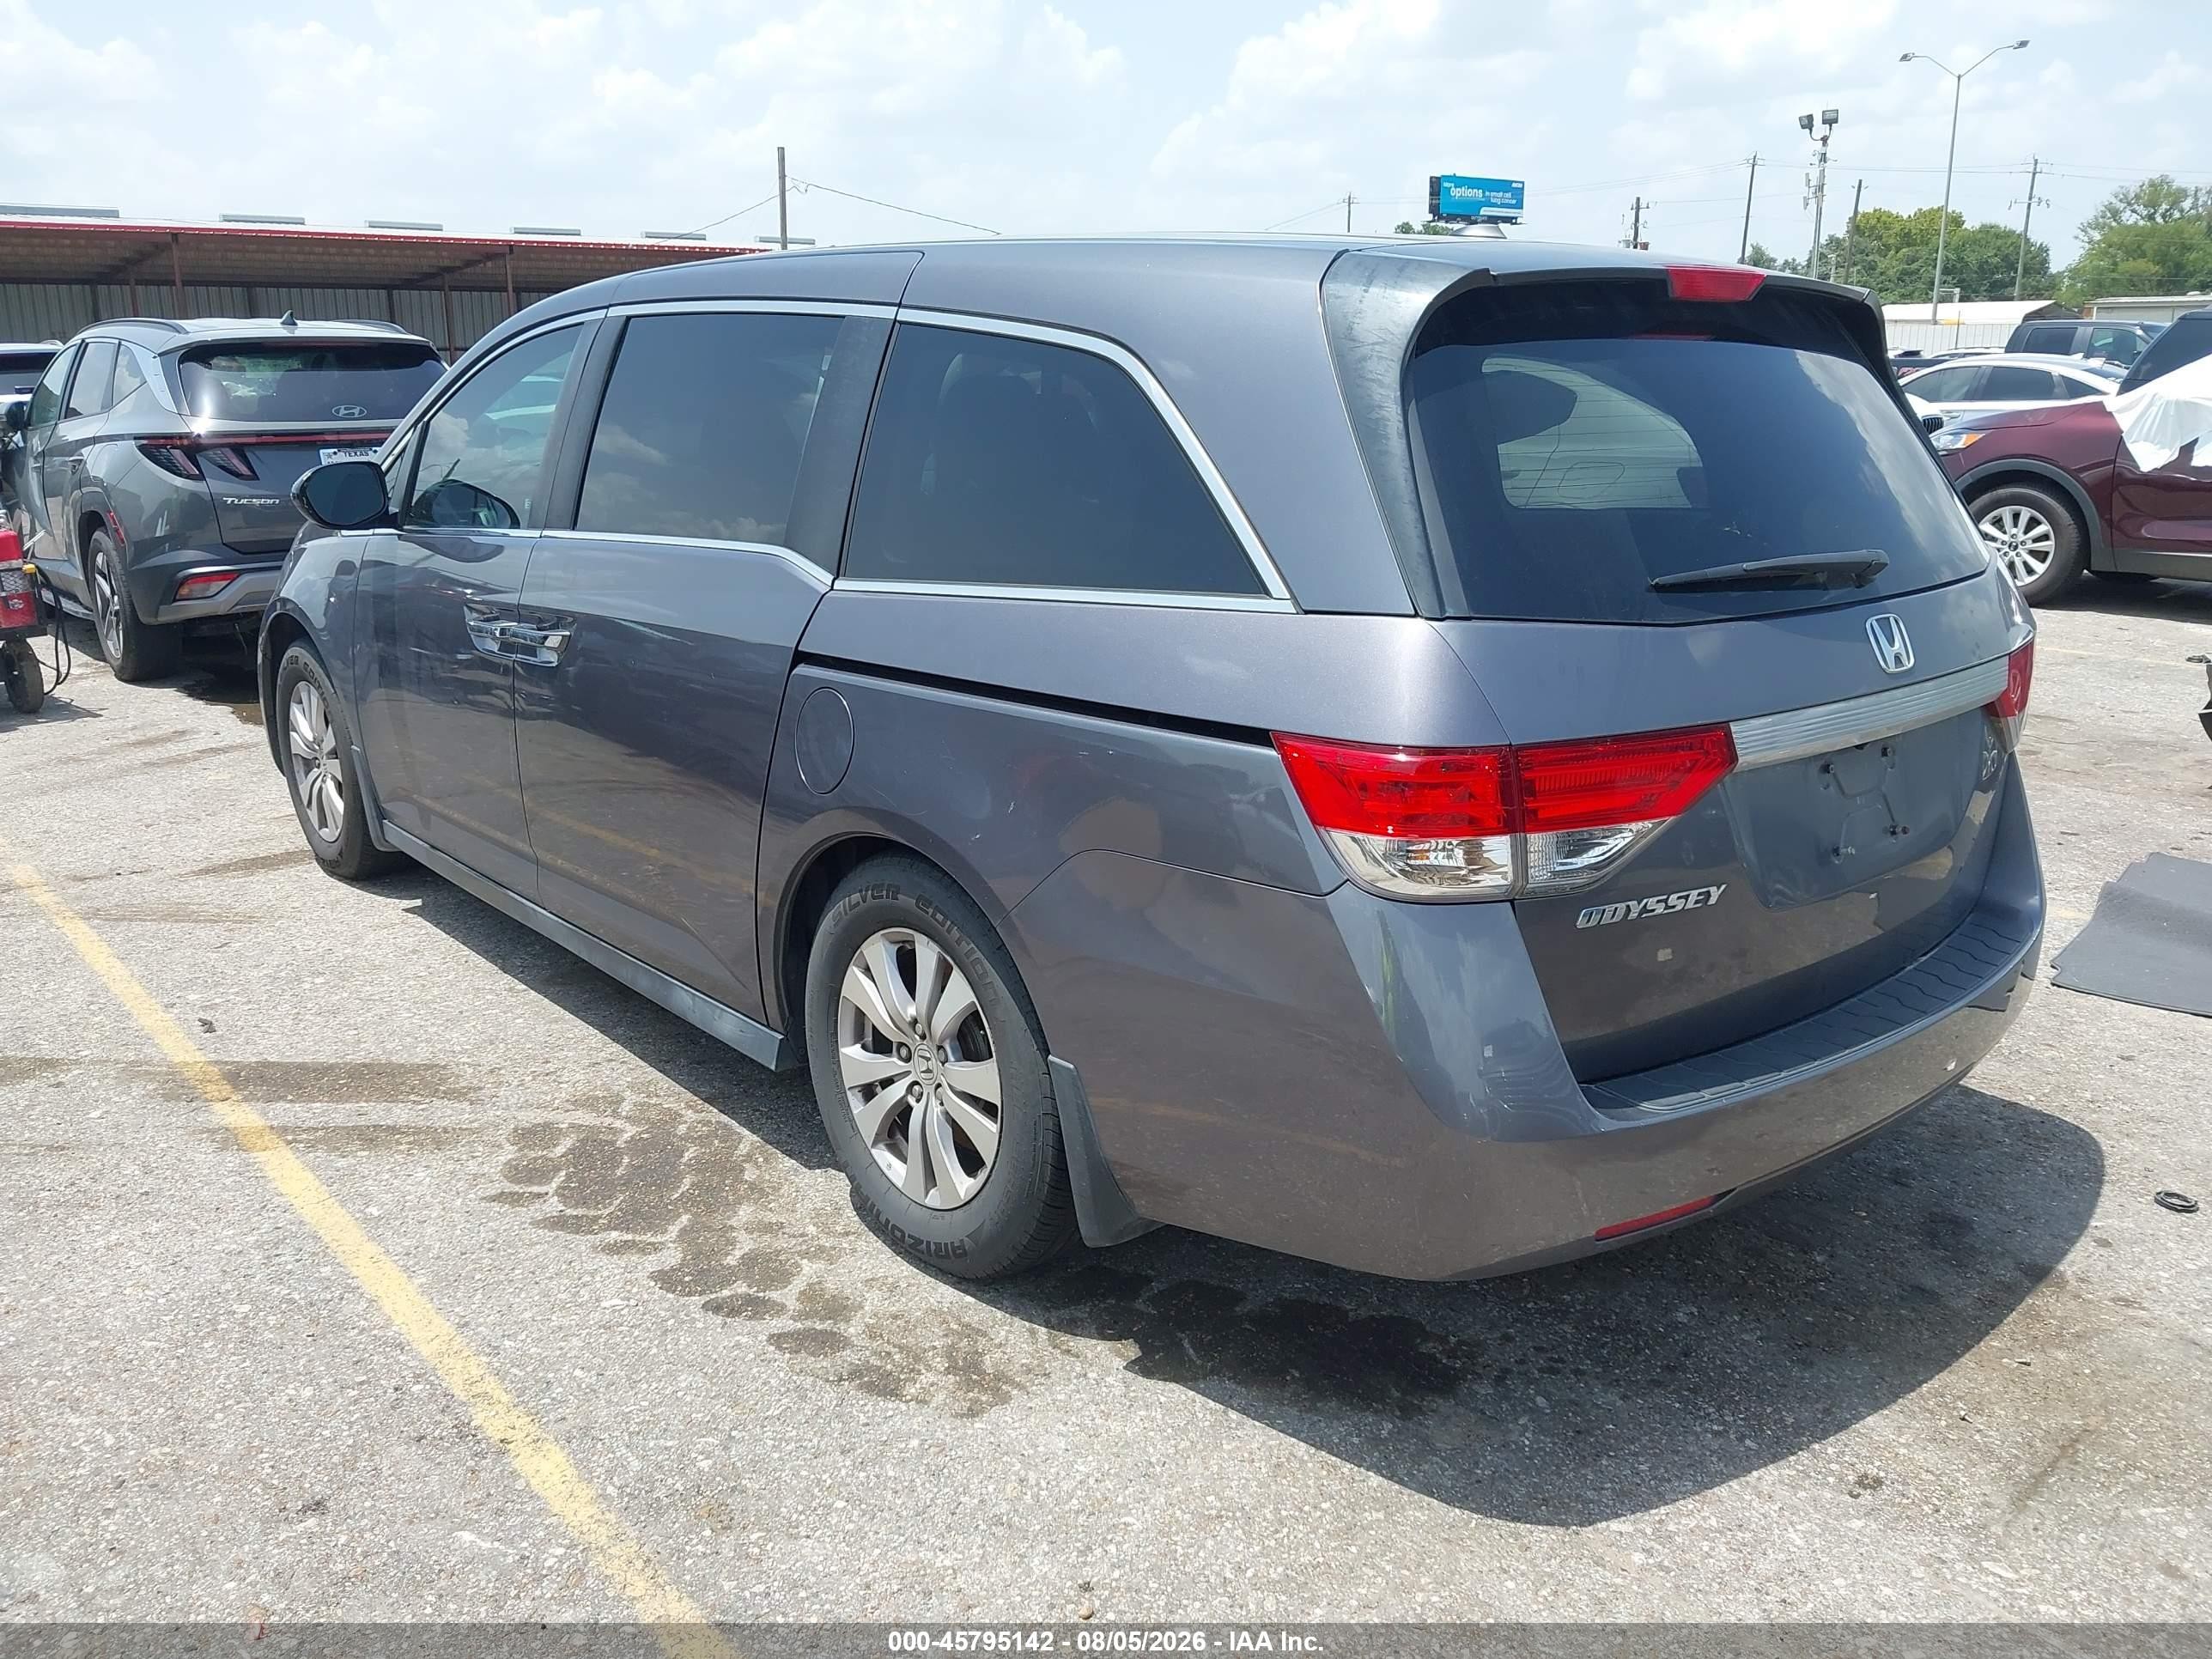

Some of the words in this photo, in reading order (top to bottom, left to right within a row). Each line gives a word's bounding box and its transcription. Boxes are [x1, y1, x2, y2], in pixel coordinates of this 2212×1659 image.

[1450, 185, 1483, 199] options
[1577, 884, 1728, 929] ODYSSEY
[830, 883, 901, 927] SILVER
[915, 893, 1002, 1006] EDITION
